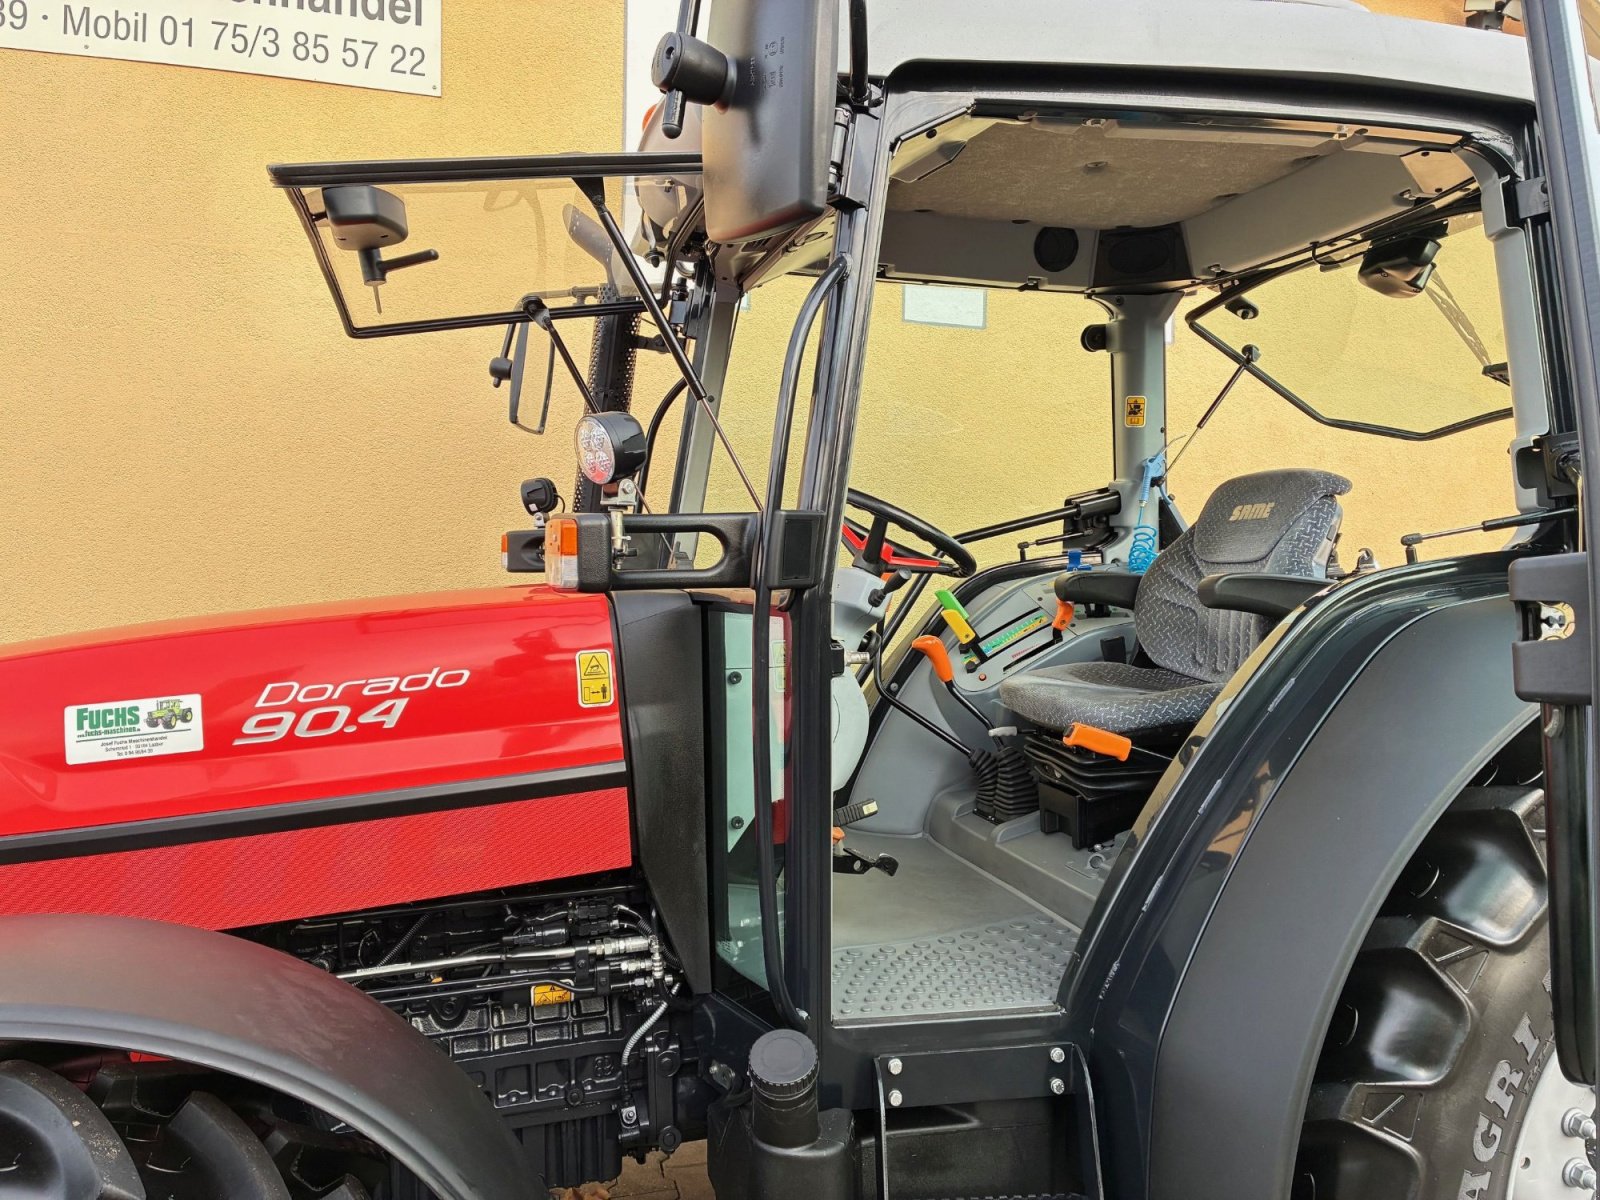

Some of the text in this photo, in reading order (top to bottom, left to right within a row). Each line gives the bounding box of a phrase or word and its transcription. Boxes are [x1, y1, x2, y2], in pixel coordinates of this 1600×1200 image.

[63, 4, 147, 43] Mobil
[160, 15, 194, 47] 01
[211, 20, 280, 58] 75/3
[293, 31, 330, 64] 85
[341, 37, 379, 70] 57
[390, 44, 427, 77] 22
[1229, 502, 1275, 521] SAME
[254, 666, 470, 708] Dorado
[231, 696, 410, 746] 90.4
